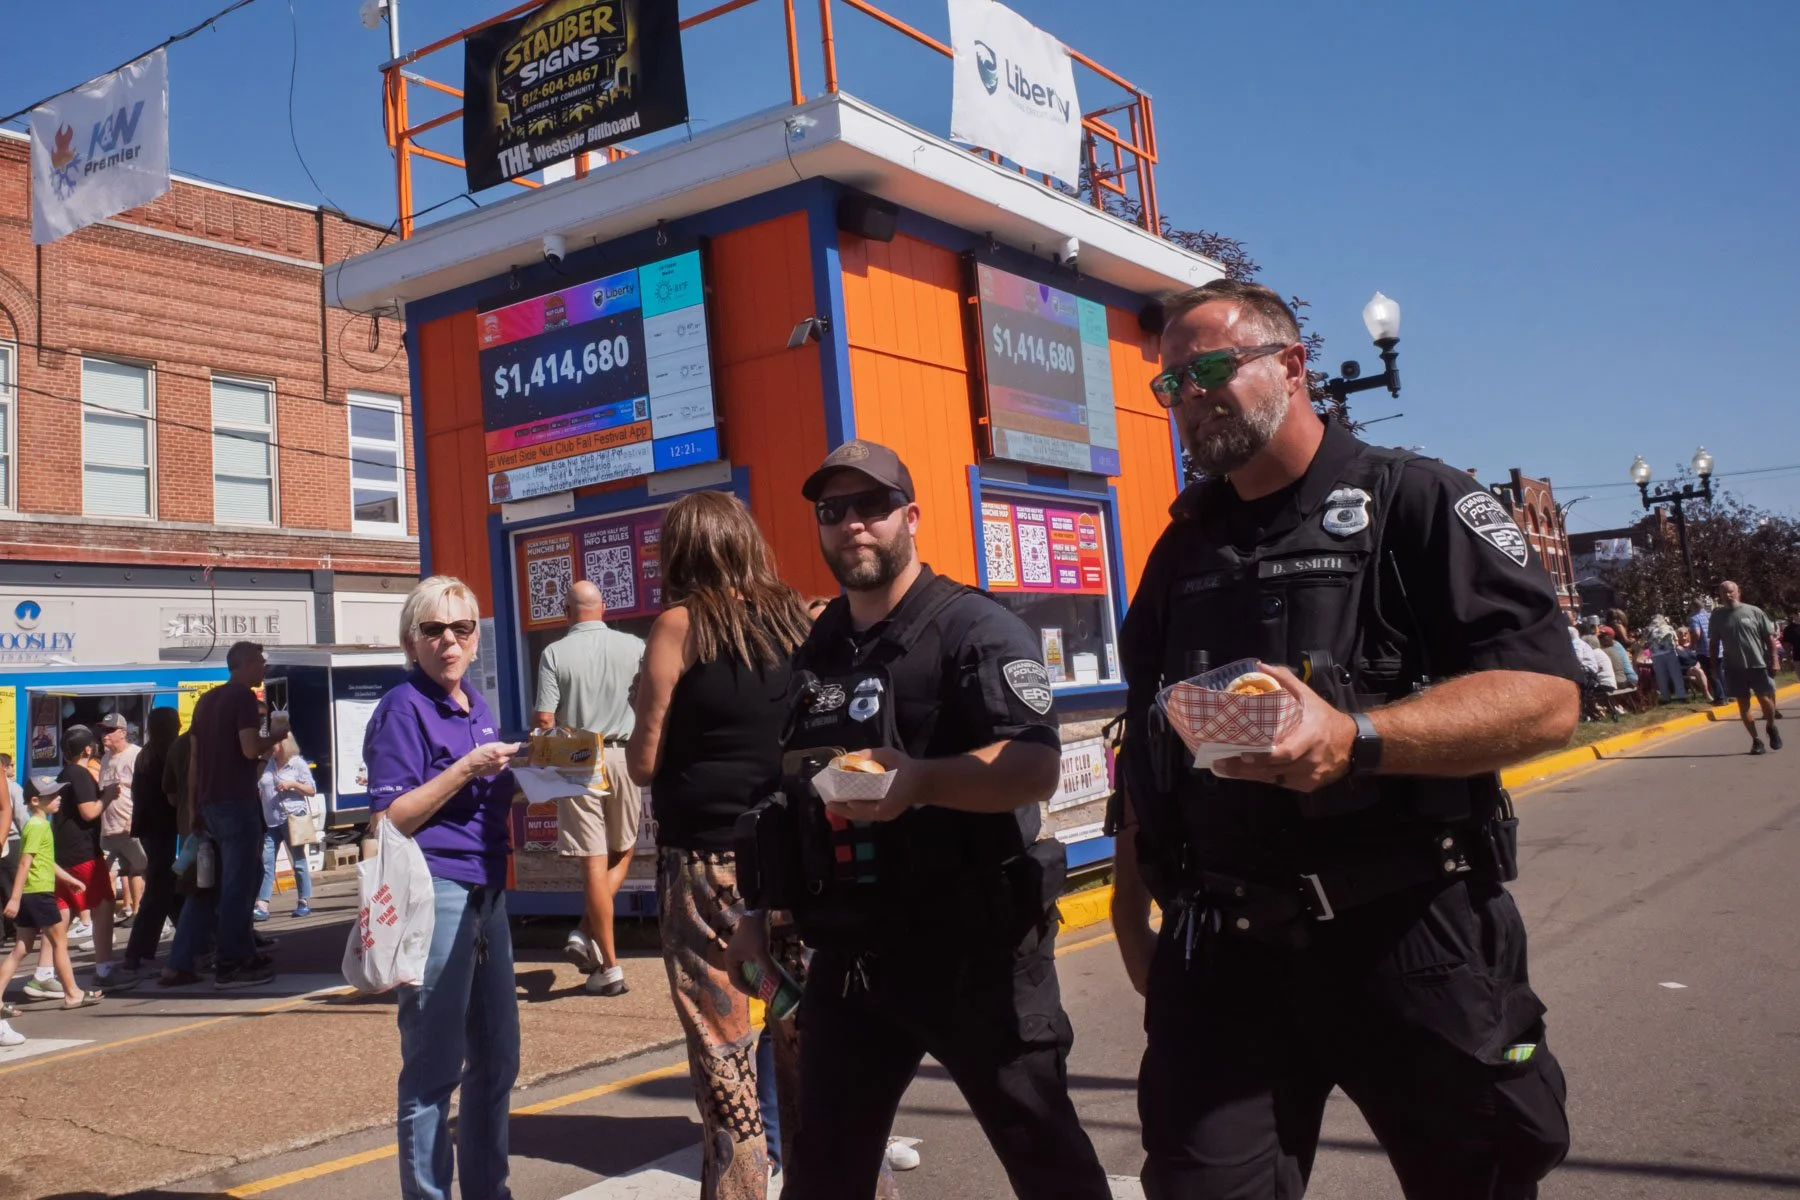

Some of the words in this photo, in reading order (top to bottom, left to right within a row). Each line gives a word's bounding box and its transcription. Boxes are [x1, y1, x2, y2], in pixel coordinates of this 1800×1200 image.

[503, 5, 617, 76] STAUBER
[519, 37, 600, 87] SIGNS
[522, 65, 599, 108] 812-604-8467
[1005, 58, 1070, 124] Libery
[525, 99, 551, 115] INSPIRED
[550, 95, 559, 105] BY
[560, 83, 596, 102] COMMUNITY
[86, 100, 145, 161] K&W
[497, 142, 534, 178] THE
[534, 134, 586, 163] Westside
[587, 111, 641, 143] Billboard
[84, 144, 142, 177] Premier
[605, 283, 635, 299] Liberty
[992, 323, 1075, 375] $1,414,680
[494, 334, 629, 399] $1,414,680
[497, 453, 518, 466] West
[520, 449, 537, 461] Side
[539, 446, 553, 457] Nut
[555, 438, 575, 454] Club
[576, 434, 592, 450] Fall
[594, 429, 627, 445] Festival
[630, 426, 647, 440] App
[670, 443, 695, 458] 12:21
[527, 545, 554, 556] MUNCHIE
[555, 542, 570, 551] MAP
[584, 537, 600, 547] INFO
[608, 532, 629, 543] RULES
[1273, 563, 1287, 574] D.
[1296, 557, 1342, 571] SMITH
[177, 613, 280, 635] TRIBLE
[0, 632, 76, 650] OOSLEY
[1022, 687, 1051, 701] EPD
[1061, 756, 1073, 775] NUT
[1075, 753, 1091, 772] CLUB
[1064, 775, 1079, 794] HALF
[1081, 772, 1092, 789] POT
[528, 820, 542, 829] NUT
[543, 820, 558, 829] CLU
[645, 822, 658, 840] PO
[371, 883, 390, 904] THANK
[380, 892, 393, 906] YOU
[376, 904, 397, 925] THANK
[385, 913, 399, 927] YOU
